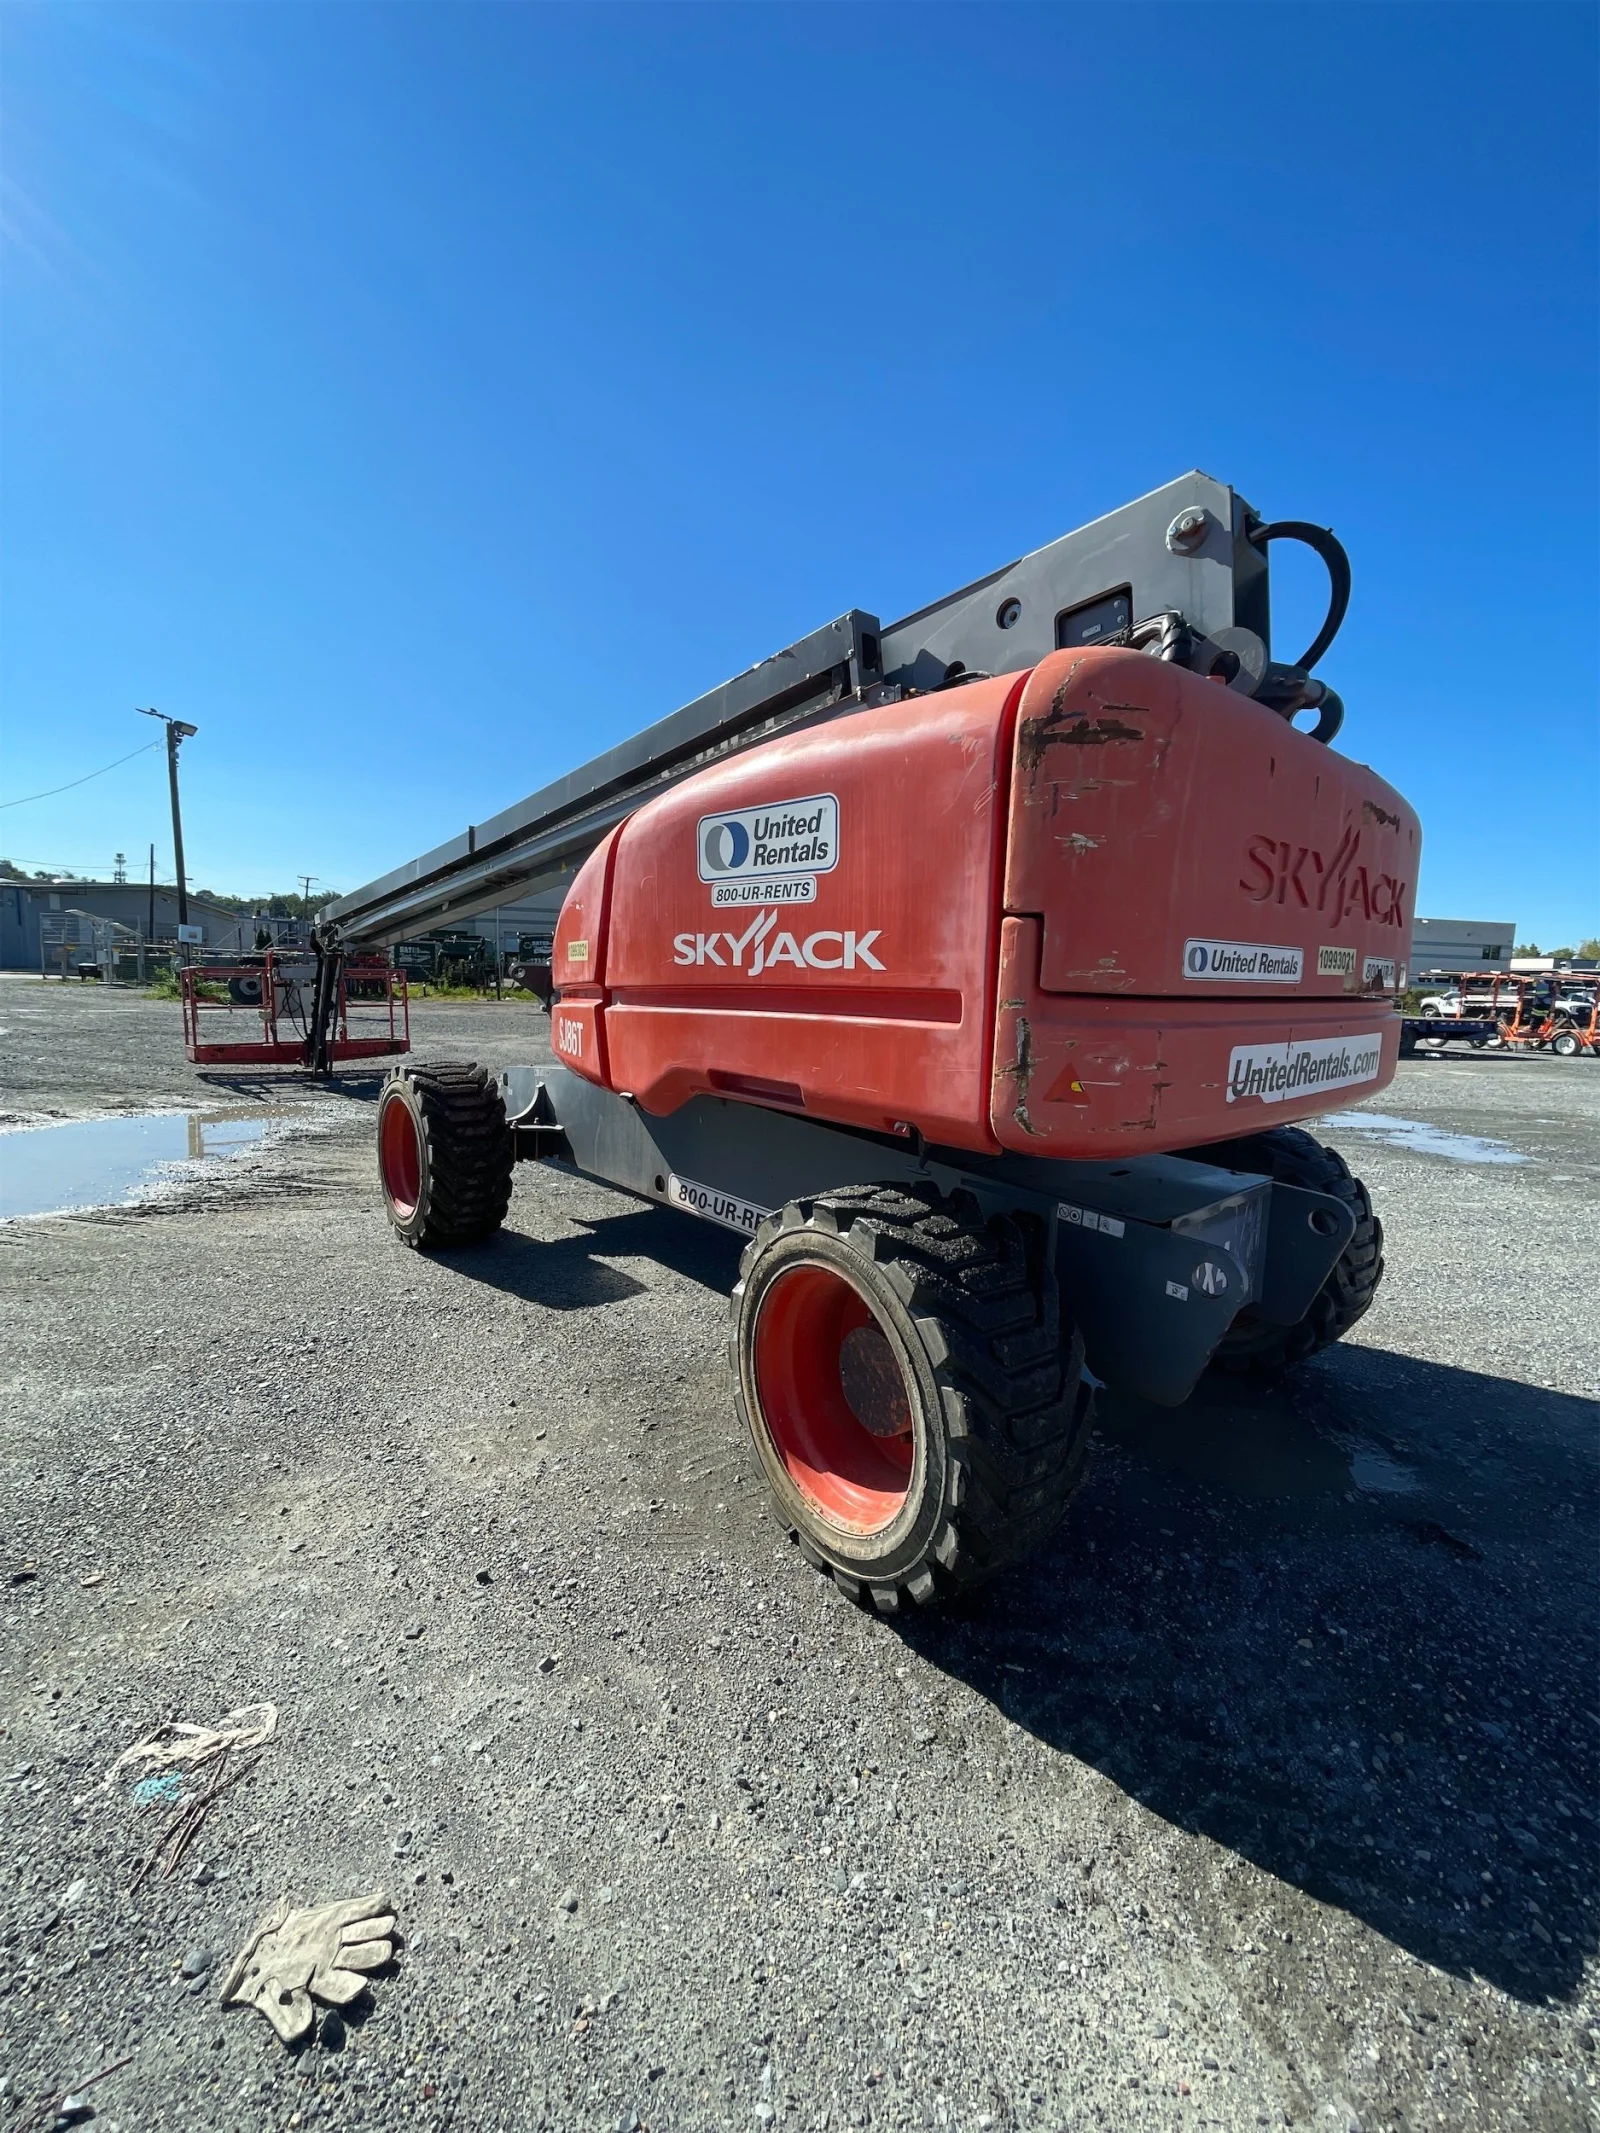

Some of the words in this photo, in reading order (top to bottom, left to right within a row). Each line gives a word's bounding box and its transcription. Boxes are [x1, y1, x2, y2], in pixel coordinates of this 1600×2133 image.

[753, 808, 823, 841] United
[752, 836, 829, 867] Rentals
[716, 881, 811, 902] 800-UR-RENTS
[1239, 824, 1406, 929] SKYJACK
[673, 908, 888, 977] SKYJACK
[1211, 949, 1258, 973] United
[1258, 953, 1299, 975] Rentals
[1320, 950, 1355, 972] 10993021
[559, 1016, 584, 1058] SJ86T
[1231, 1047, 1379, 1098] UnitedRentals.com
